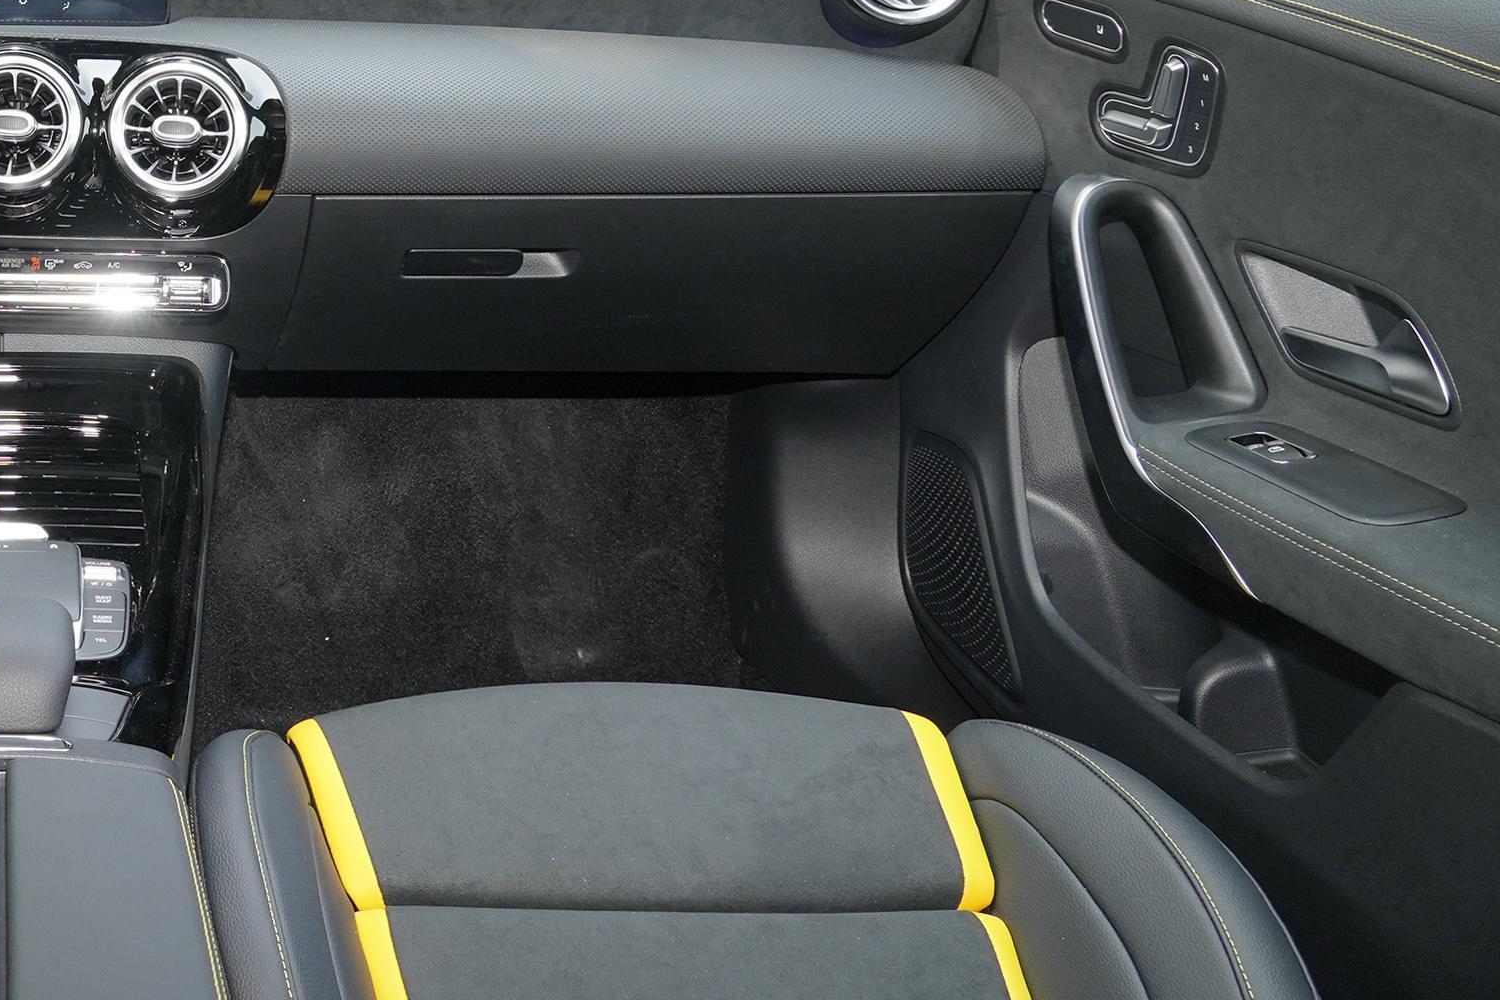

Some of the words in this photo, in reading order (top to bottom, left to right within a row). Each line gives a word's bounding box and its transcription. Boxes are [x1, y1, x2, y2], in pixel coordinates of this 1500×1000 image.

[1200, 99, 1205, 108] 1
[1194, 122, 1200, 131] 2
[1187, 145, 1193, 154] 3
[107, 261, 121, 269] A/C
